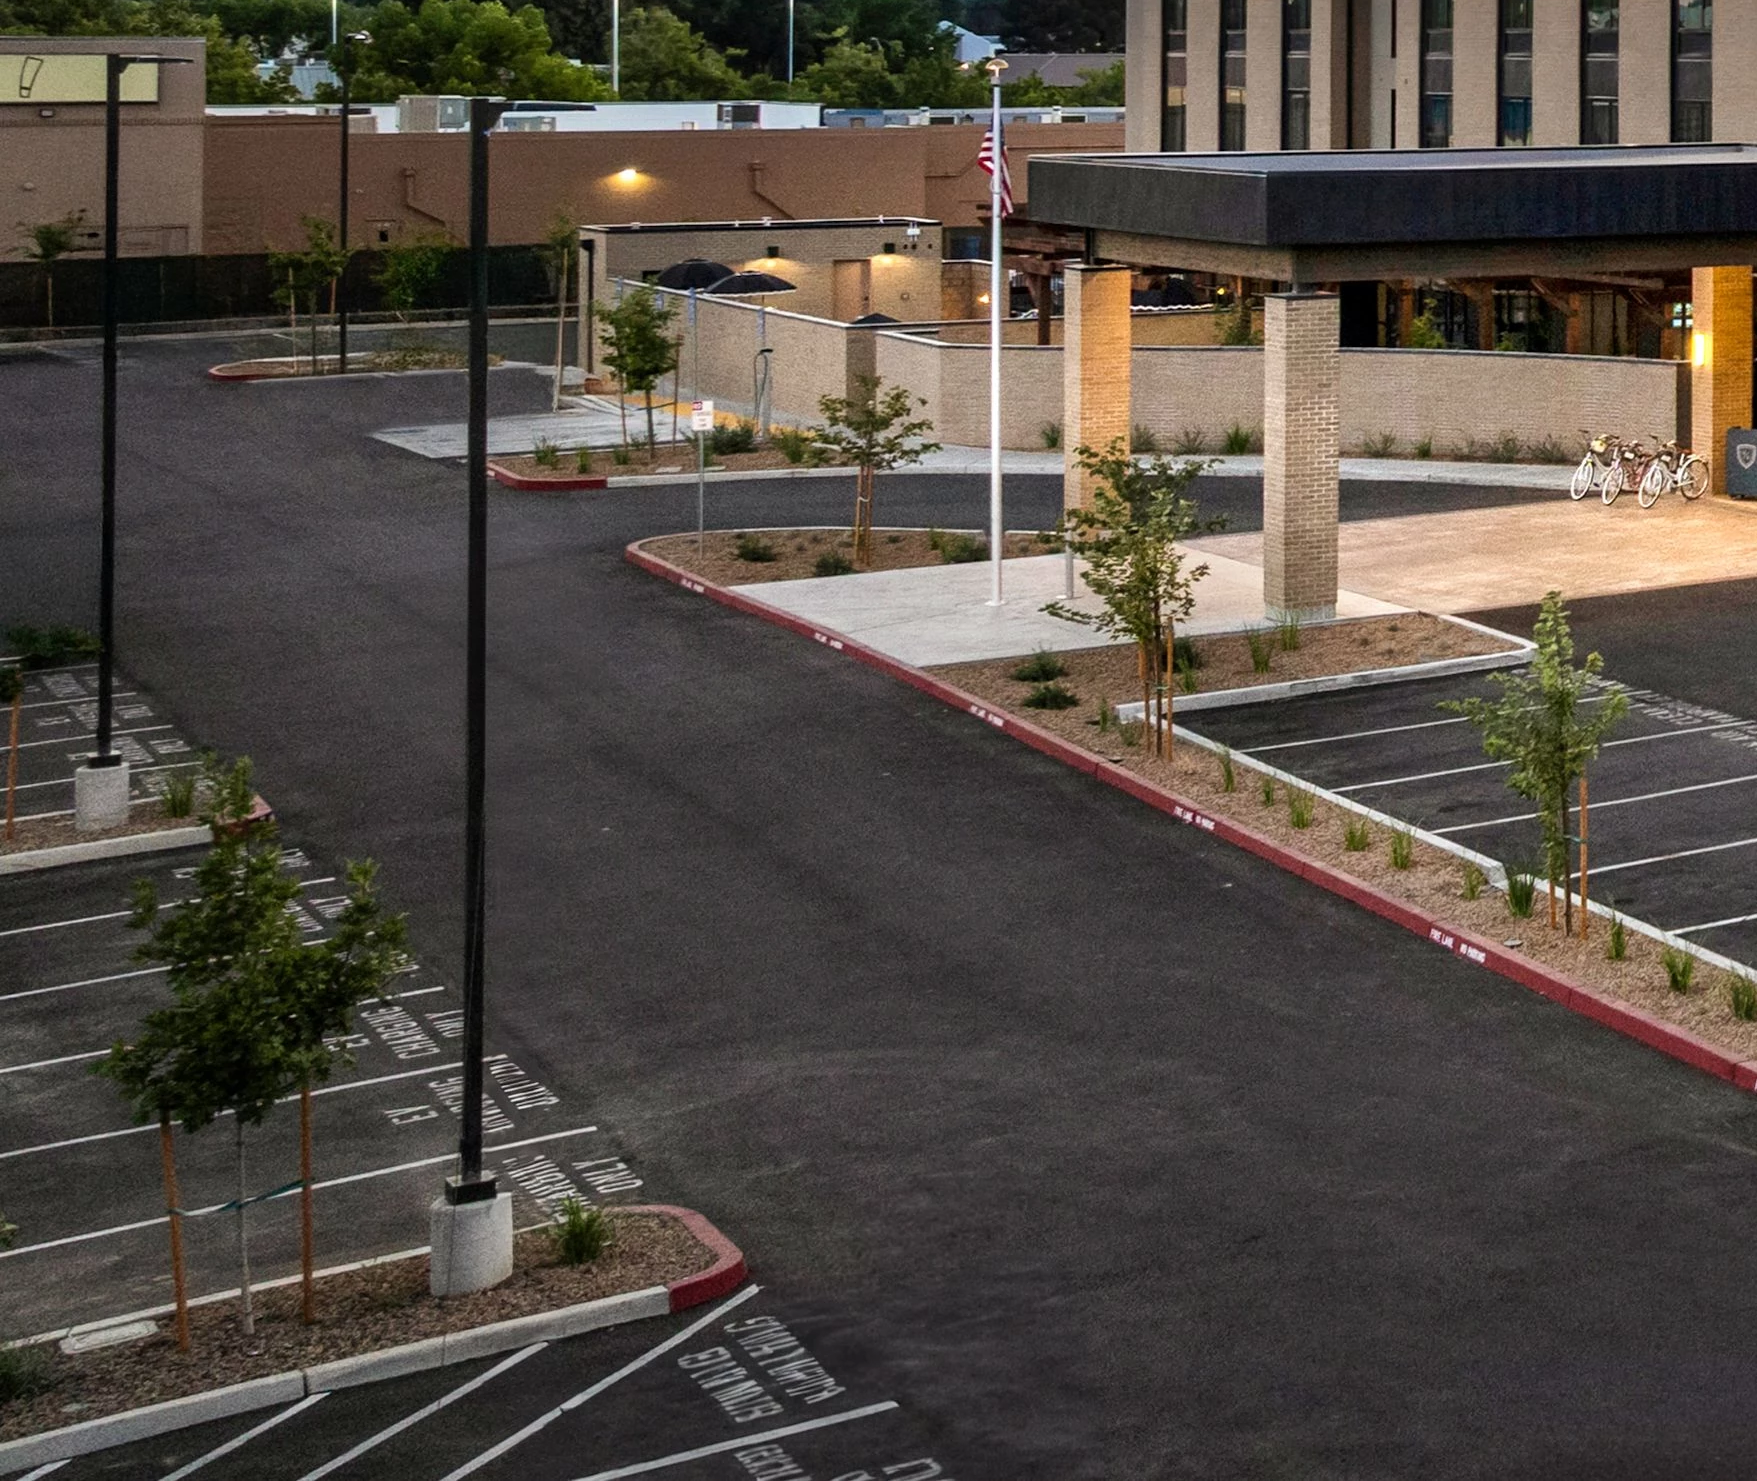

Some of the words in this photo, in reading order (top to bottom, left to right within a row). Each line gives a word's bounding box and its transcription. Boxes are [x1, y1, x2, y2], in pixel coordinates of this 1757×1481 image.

[361, 1005, 441, 1060] CHARGING
[384, 1104, 439, 1126] EV
[572, 1156, 644, 1194] ONLY
